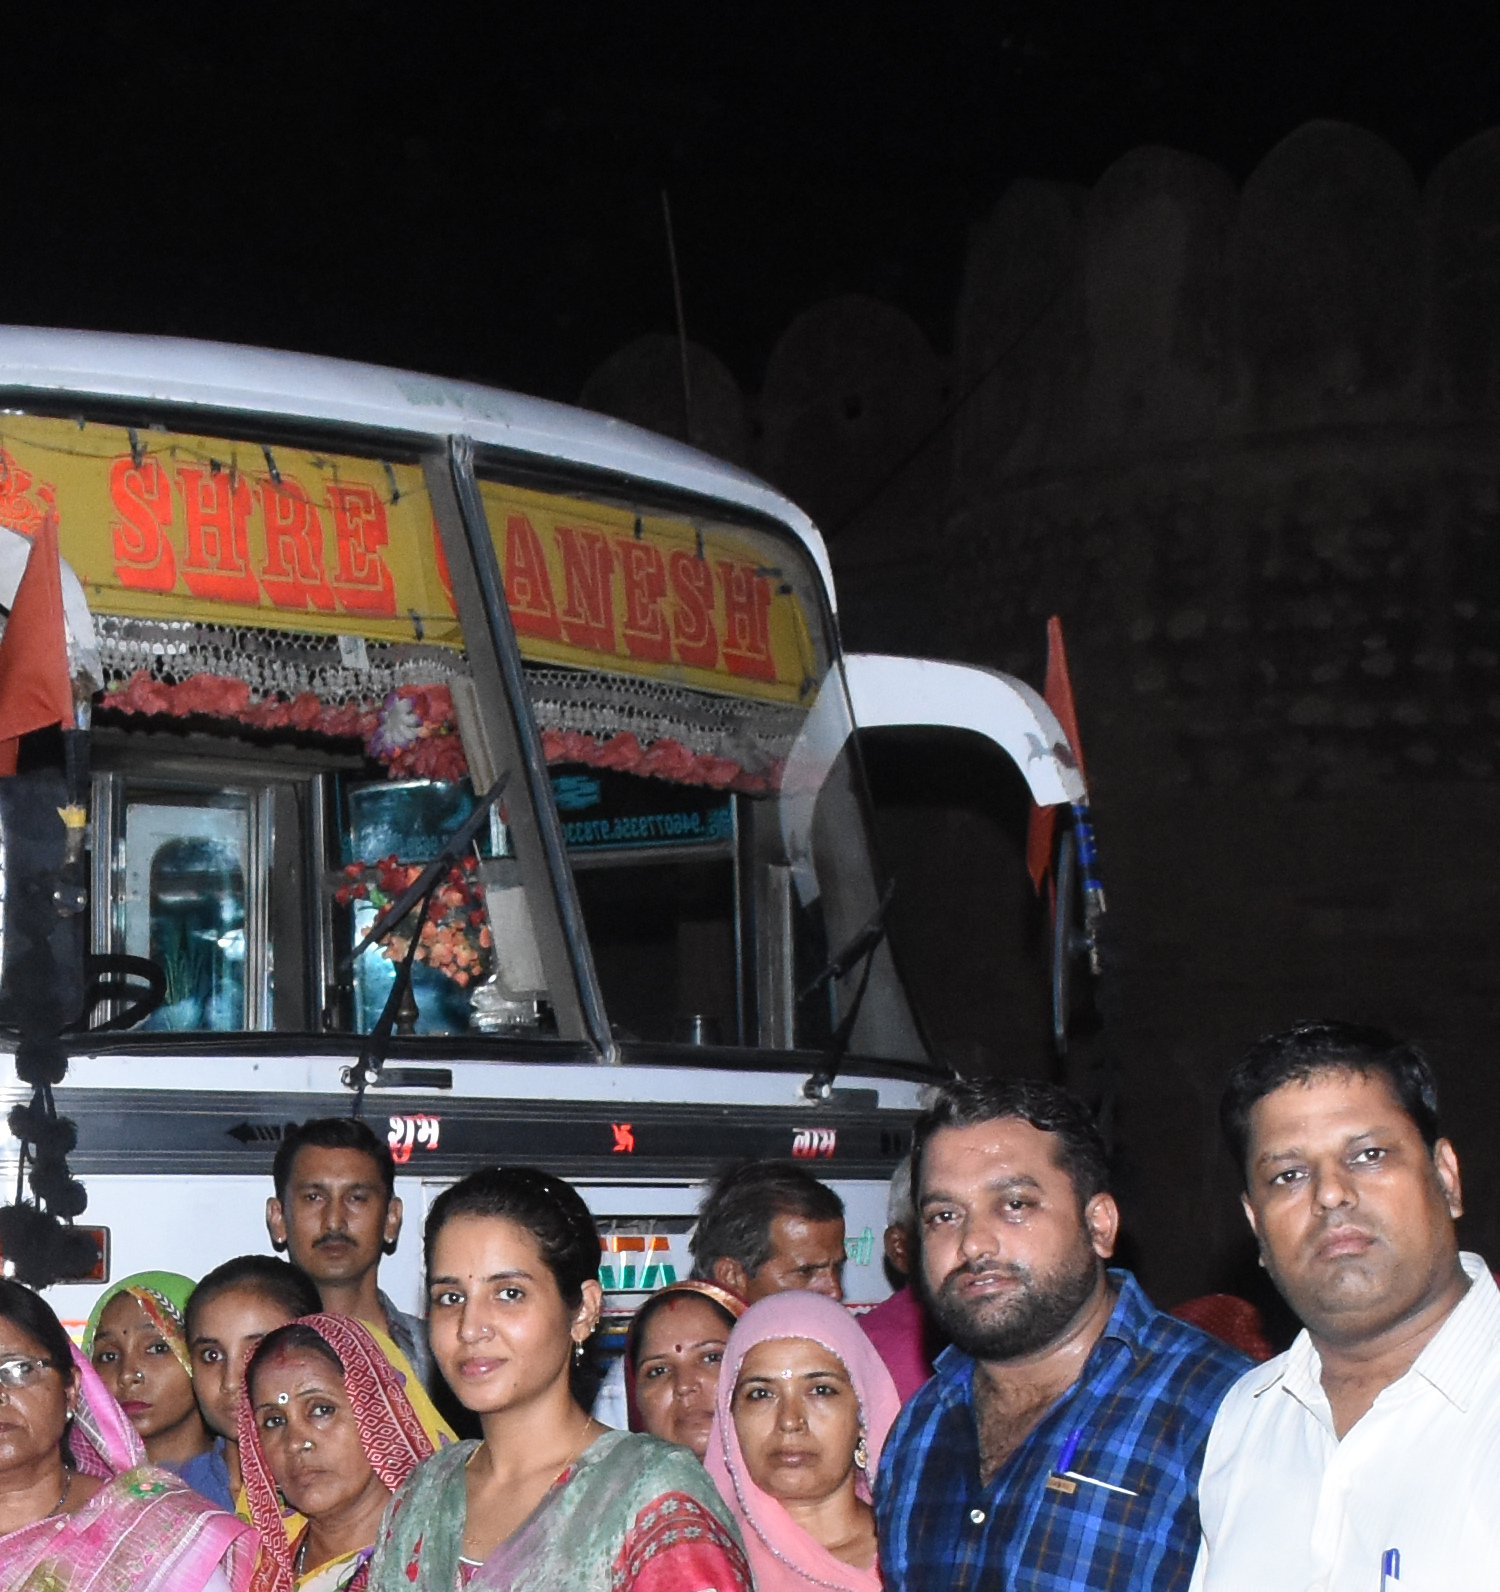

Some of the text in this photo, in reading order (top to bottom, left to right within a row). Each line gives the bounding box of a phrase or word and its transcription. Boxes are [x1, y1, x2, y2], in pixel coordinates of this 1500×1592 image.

[109, 453, 777, 683] SHRE ANESH
[387, 1113, 837, 1164] शुभ लाभ
[598, 1236, 679, 1289] TA
